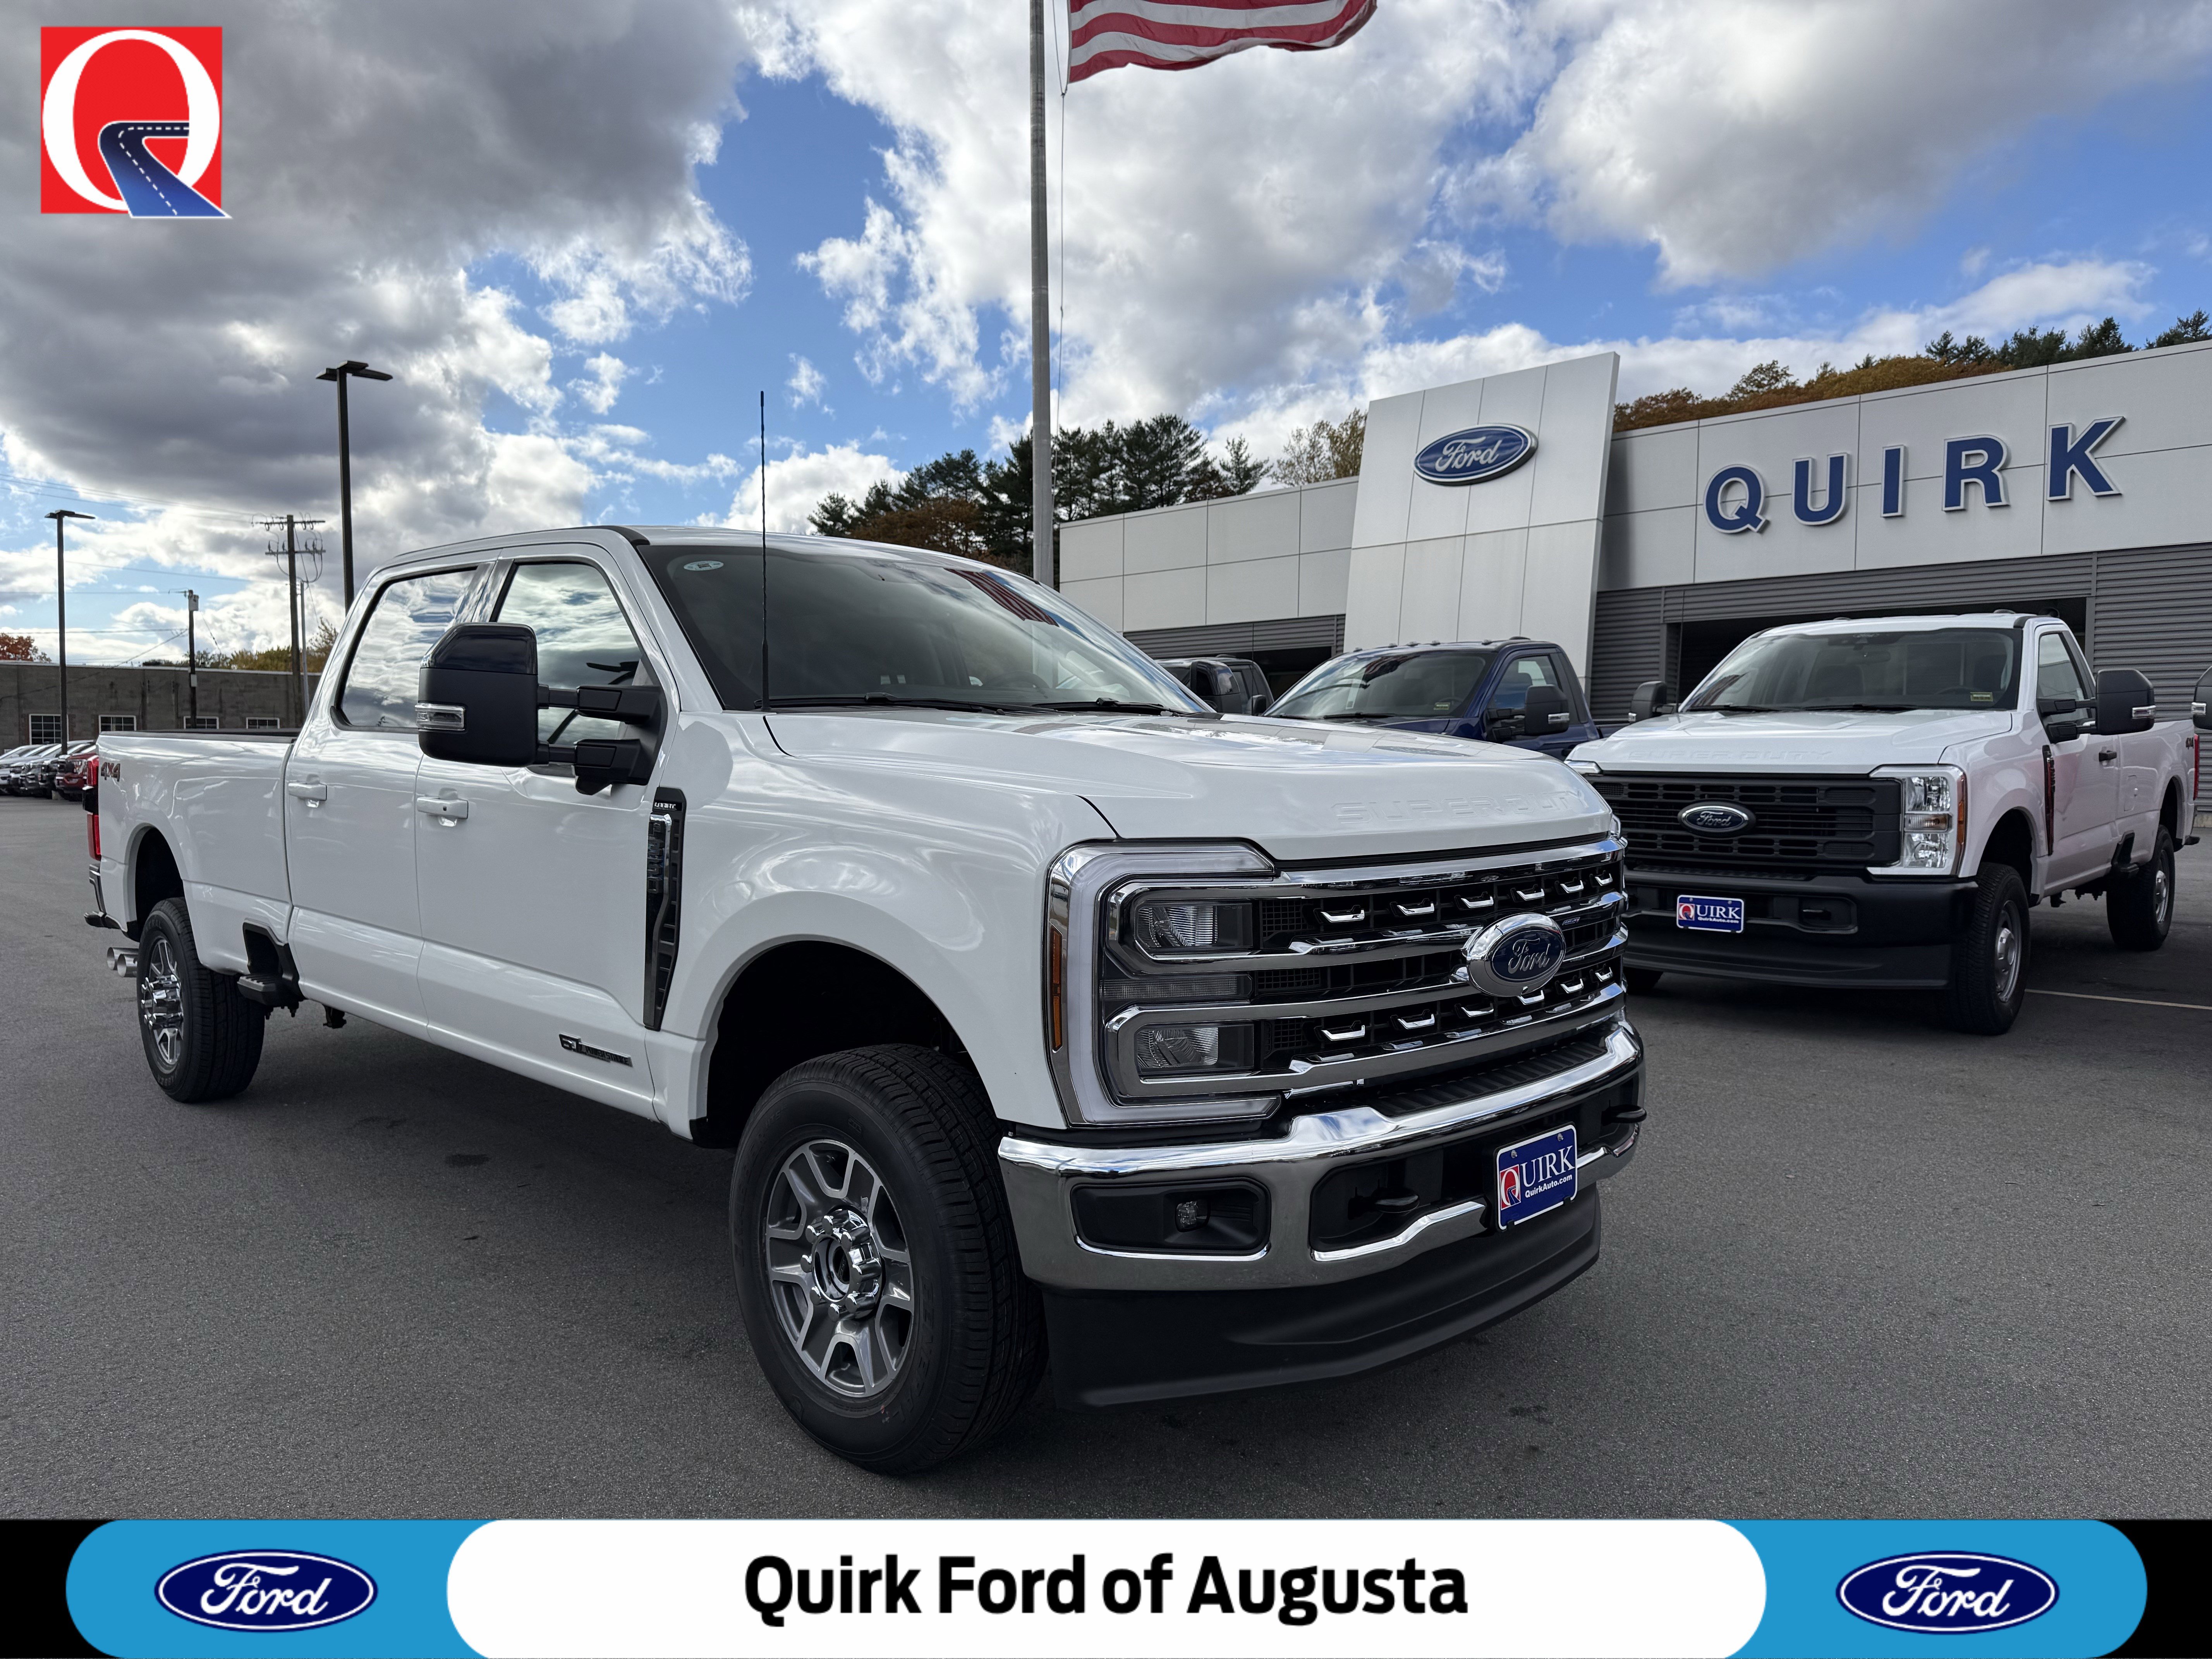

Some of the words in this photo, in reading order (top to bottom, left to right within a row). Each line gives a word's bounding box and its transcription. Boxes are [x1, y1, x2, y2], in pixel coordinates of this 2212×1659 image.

[1435, 436, 1503, 472] Ford
[1704, 415, 2126, 535] QUIRK
[1331, 795, 1505, 824] SUPER
[1696, 811, 1732, 826] Ford
[1679, 903, 1741, 921] QUIRK
[1508, 938, 1551, 974] Ford
[1501, 1145, 1575, 1206] QUIRK
[1525, 1174, 1573, 1198] QuirkAuto.com
